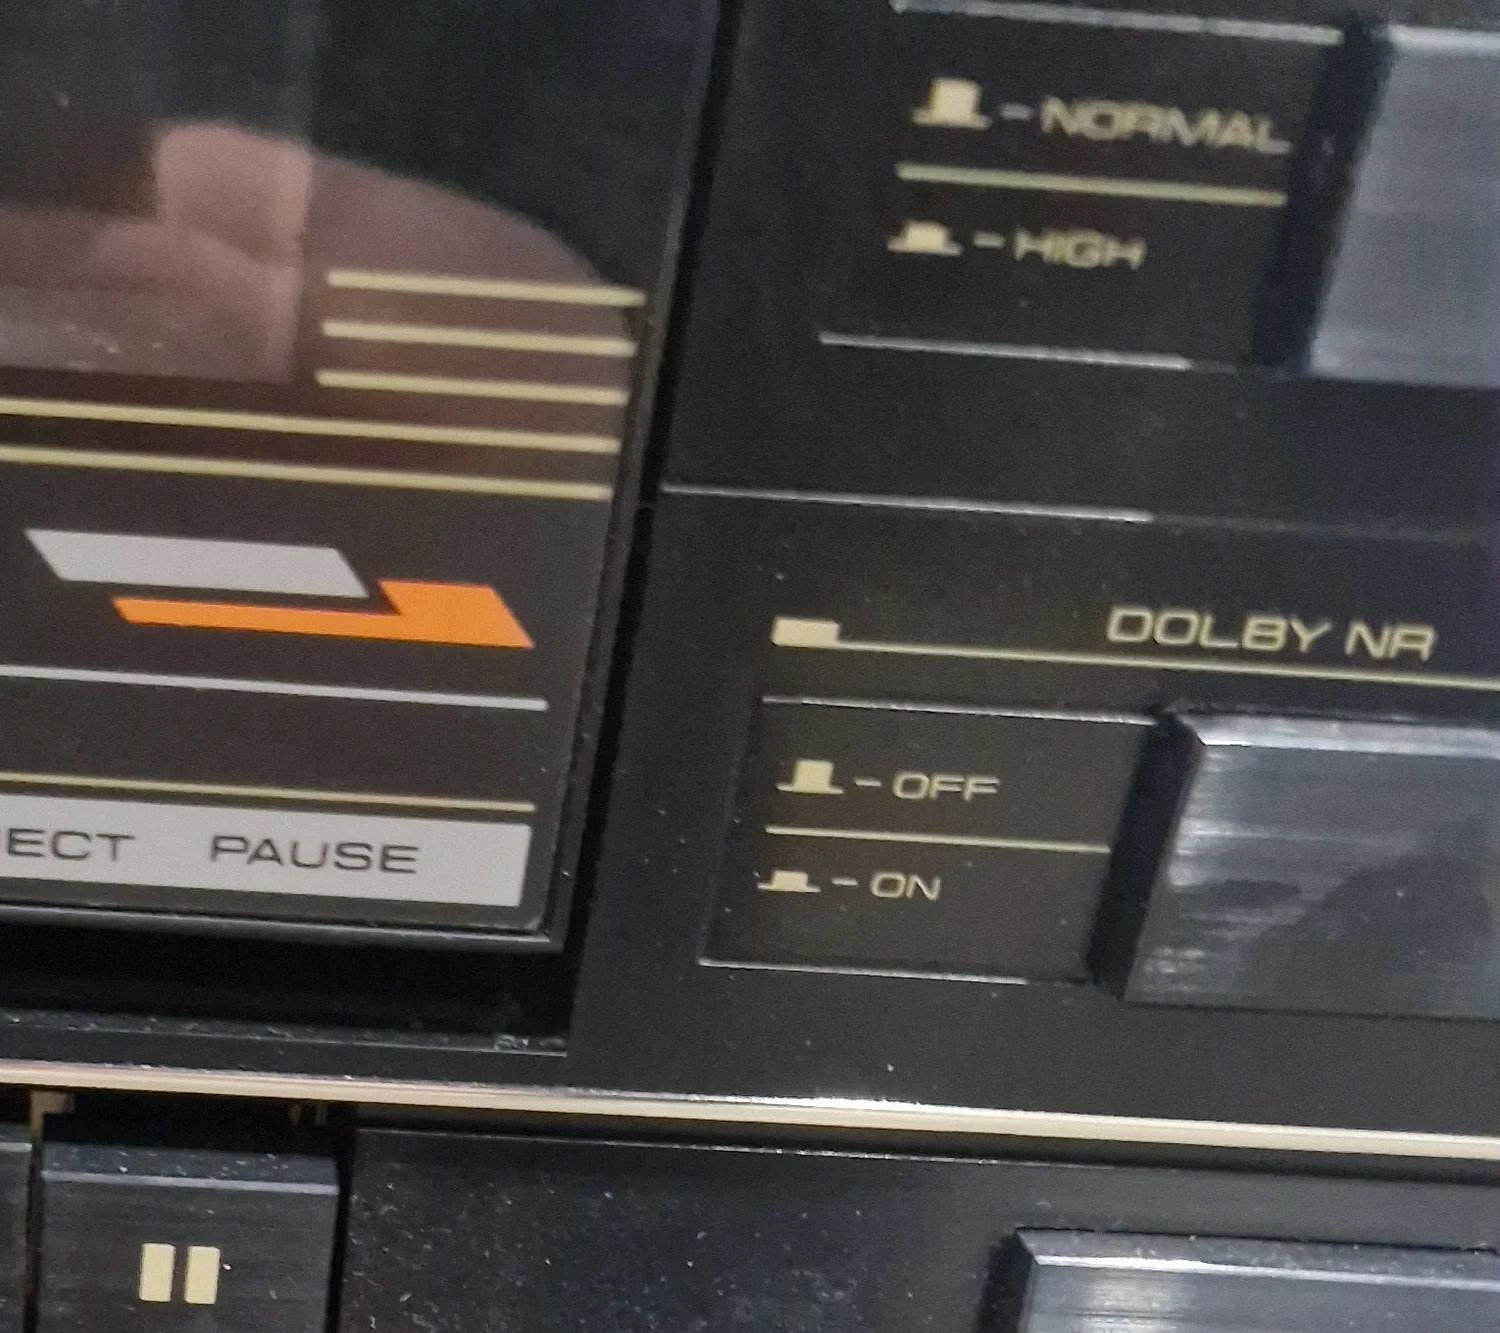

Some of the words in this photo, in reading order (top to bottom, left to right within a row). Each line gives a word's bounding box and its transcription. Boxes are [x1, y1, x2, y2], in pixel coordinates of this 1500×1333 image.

[1107, 604, 1328, 653] DOLBY
[1344, 623, 1437, 662] NR
[892, 771, 1000, 802] OFF
[210, 834, 421, 873] PAUSE
[869, 872, 941, 901] ON
